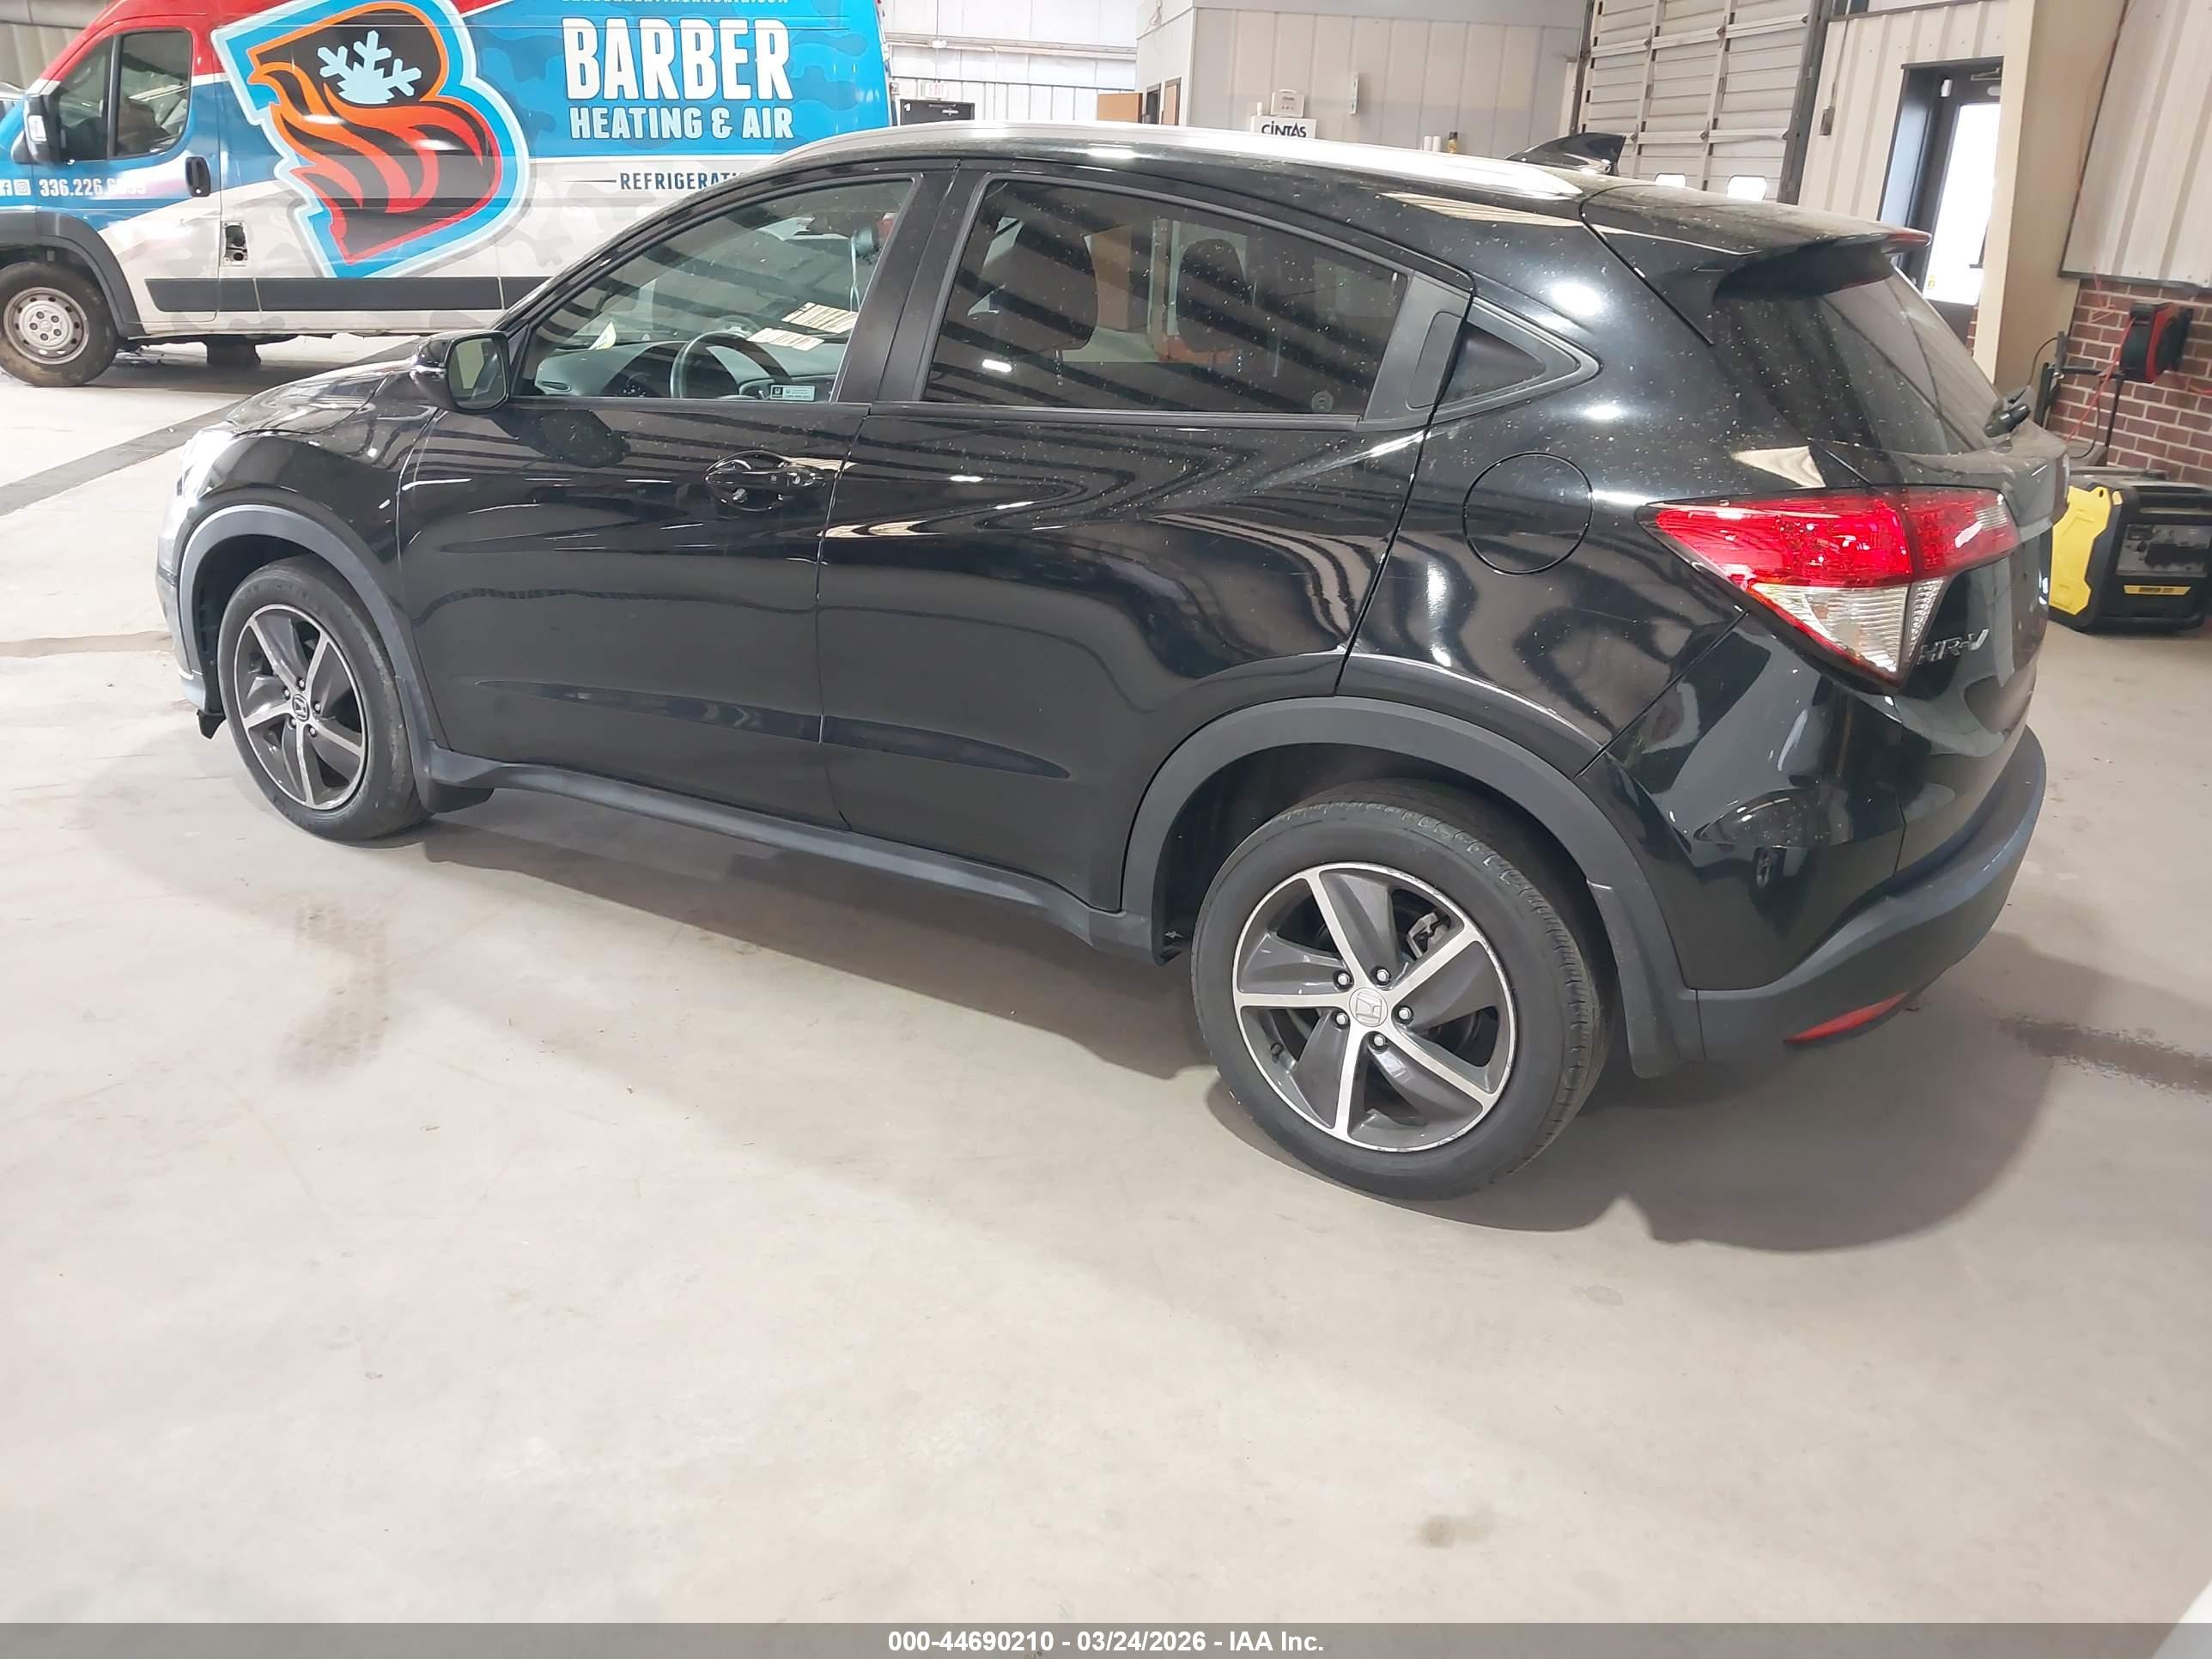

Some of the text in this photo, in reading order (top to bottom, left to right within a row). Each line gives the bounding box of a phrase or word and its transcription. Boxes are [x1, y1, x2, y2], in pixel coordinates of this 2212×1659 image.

[562, 17, 794, 100] BARBER
[569, 107, 794, 139] HEATING & AIR
